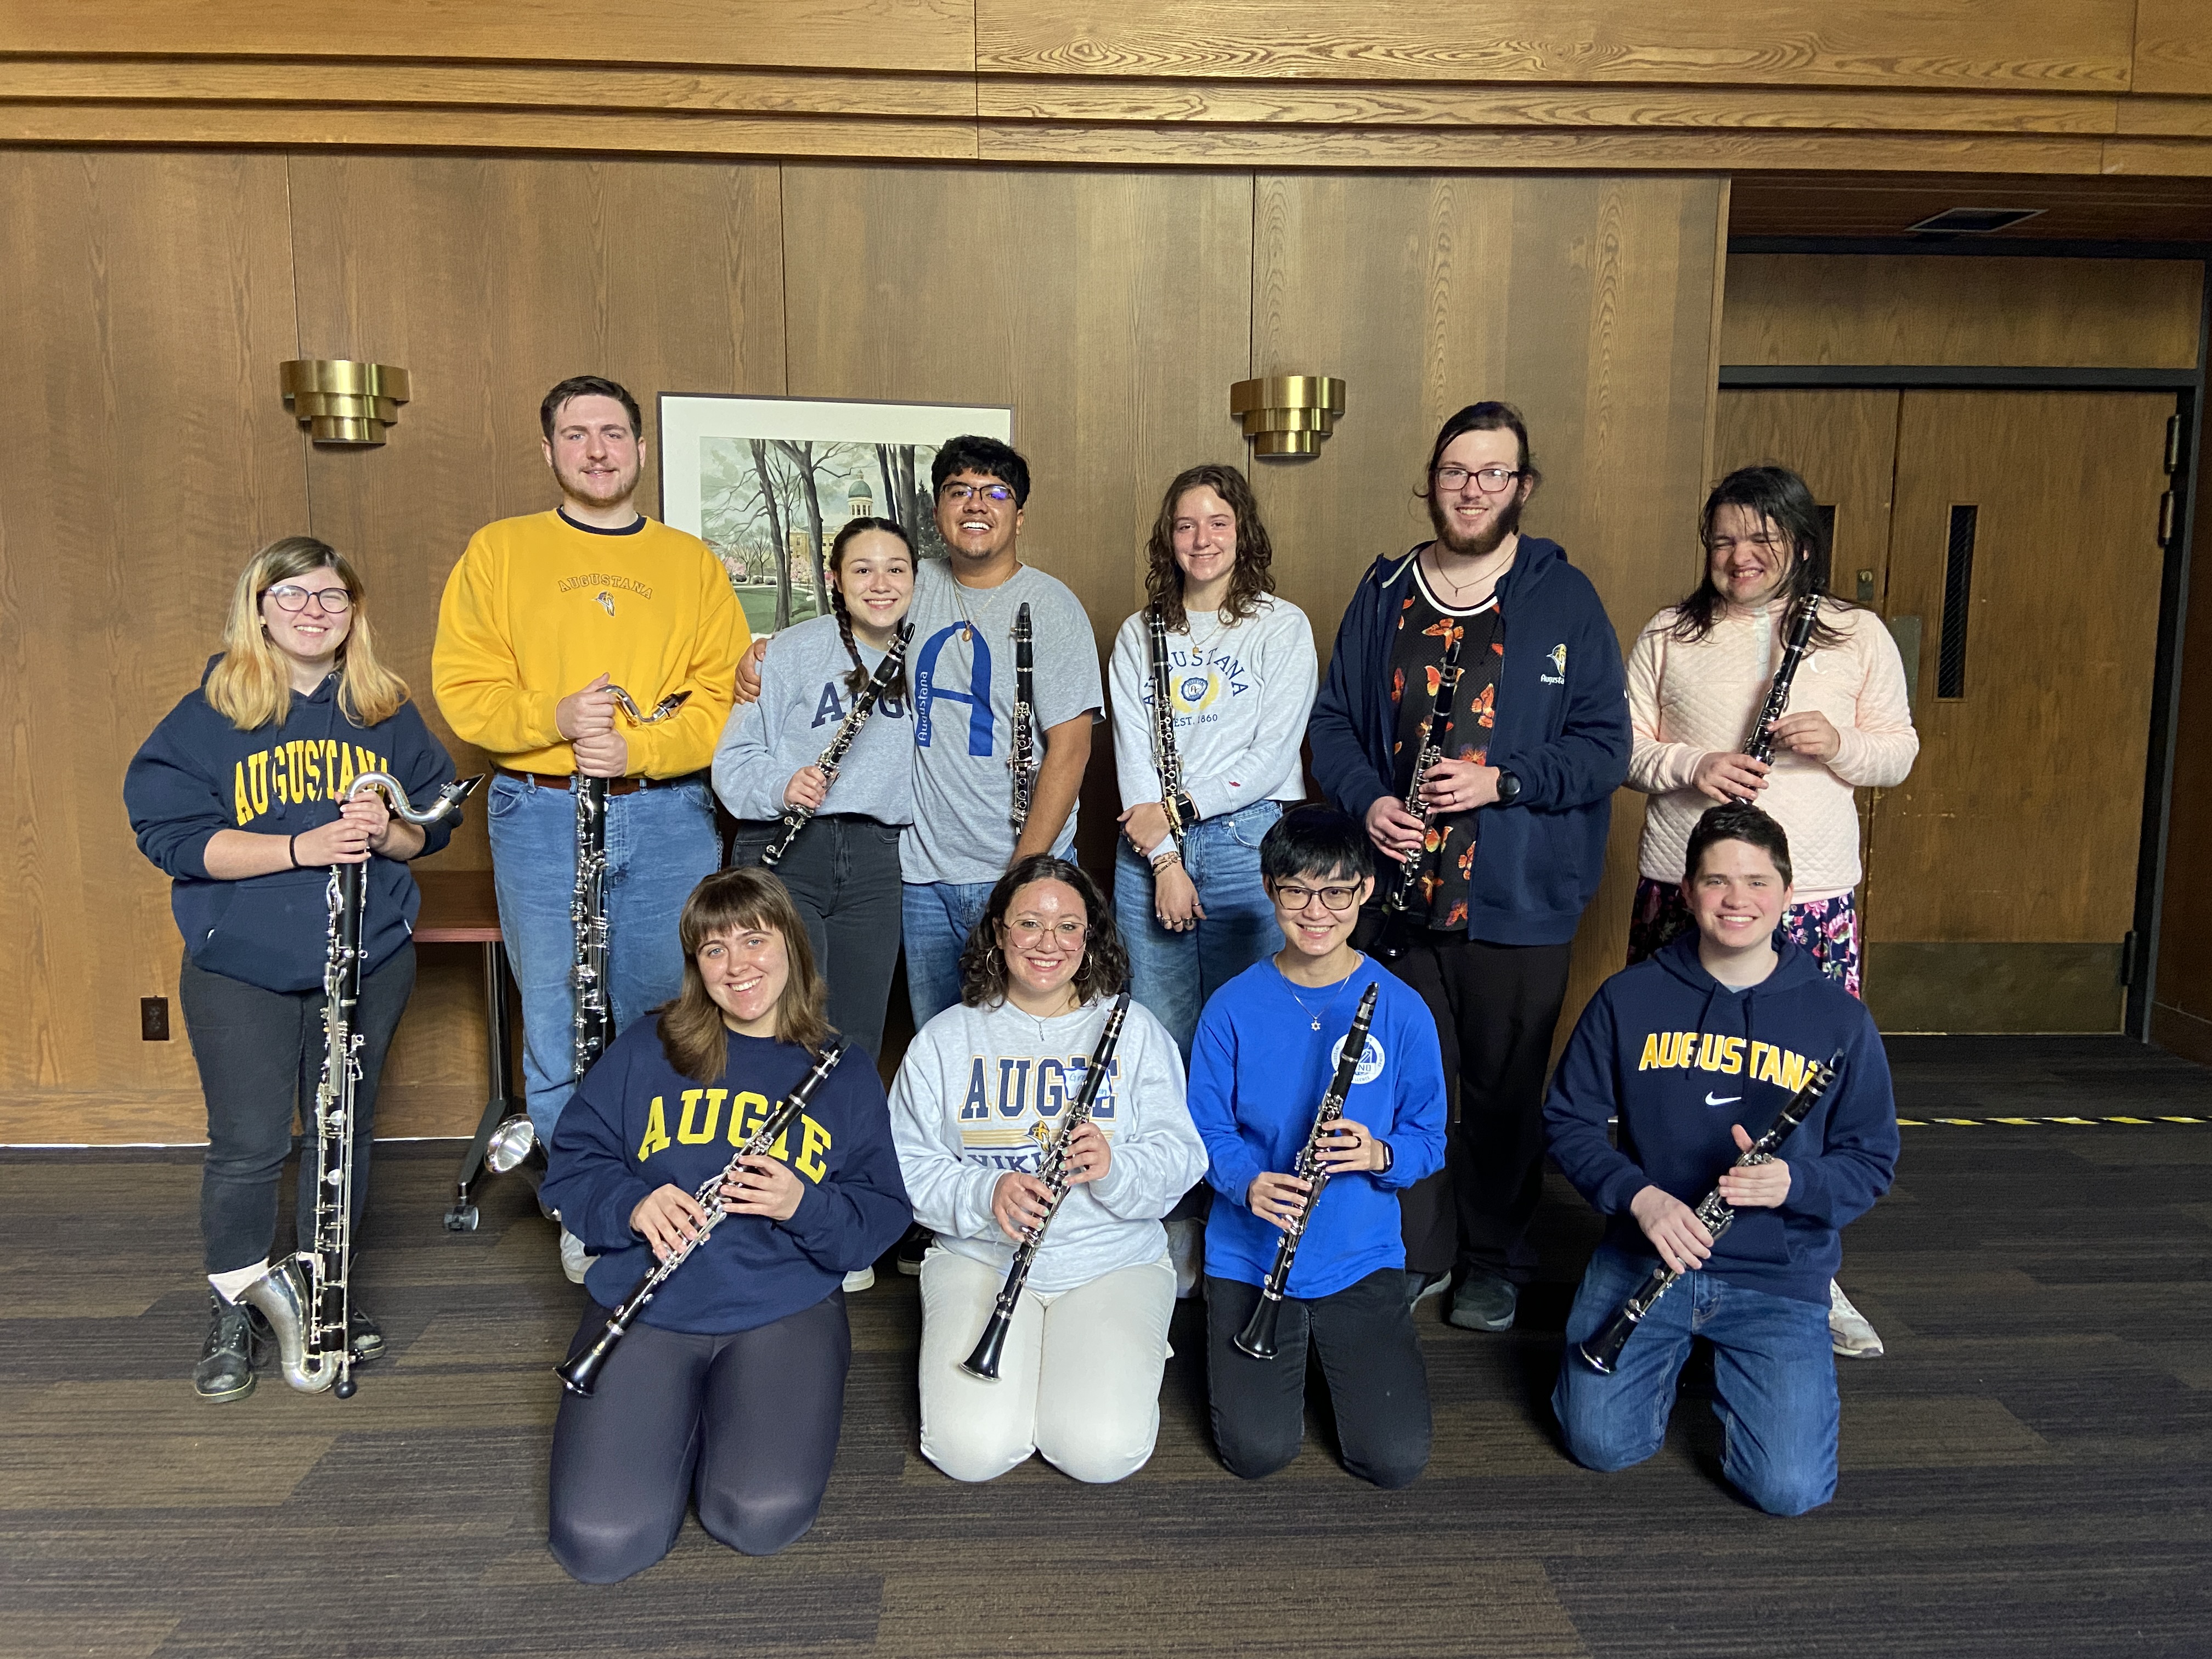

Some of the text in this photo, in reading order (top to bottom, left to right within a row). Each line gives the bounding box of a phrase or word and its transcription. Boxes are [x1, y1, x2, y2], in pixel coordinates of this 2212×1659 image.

[557, 573, 653, 600] AUGUSTANA
[917, 671, 928, 741] Augustana
[1143, 647, 1249, 706] AUSTANA
[1174, 714, 1218, 726] EST. 1860
[235, 740, 387, 826] AUGUSTAN
[958, 1054, 1121, 1121] AUGE
